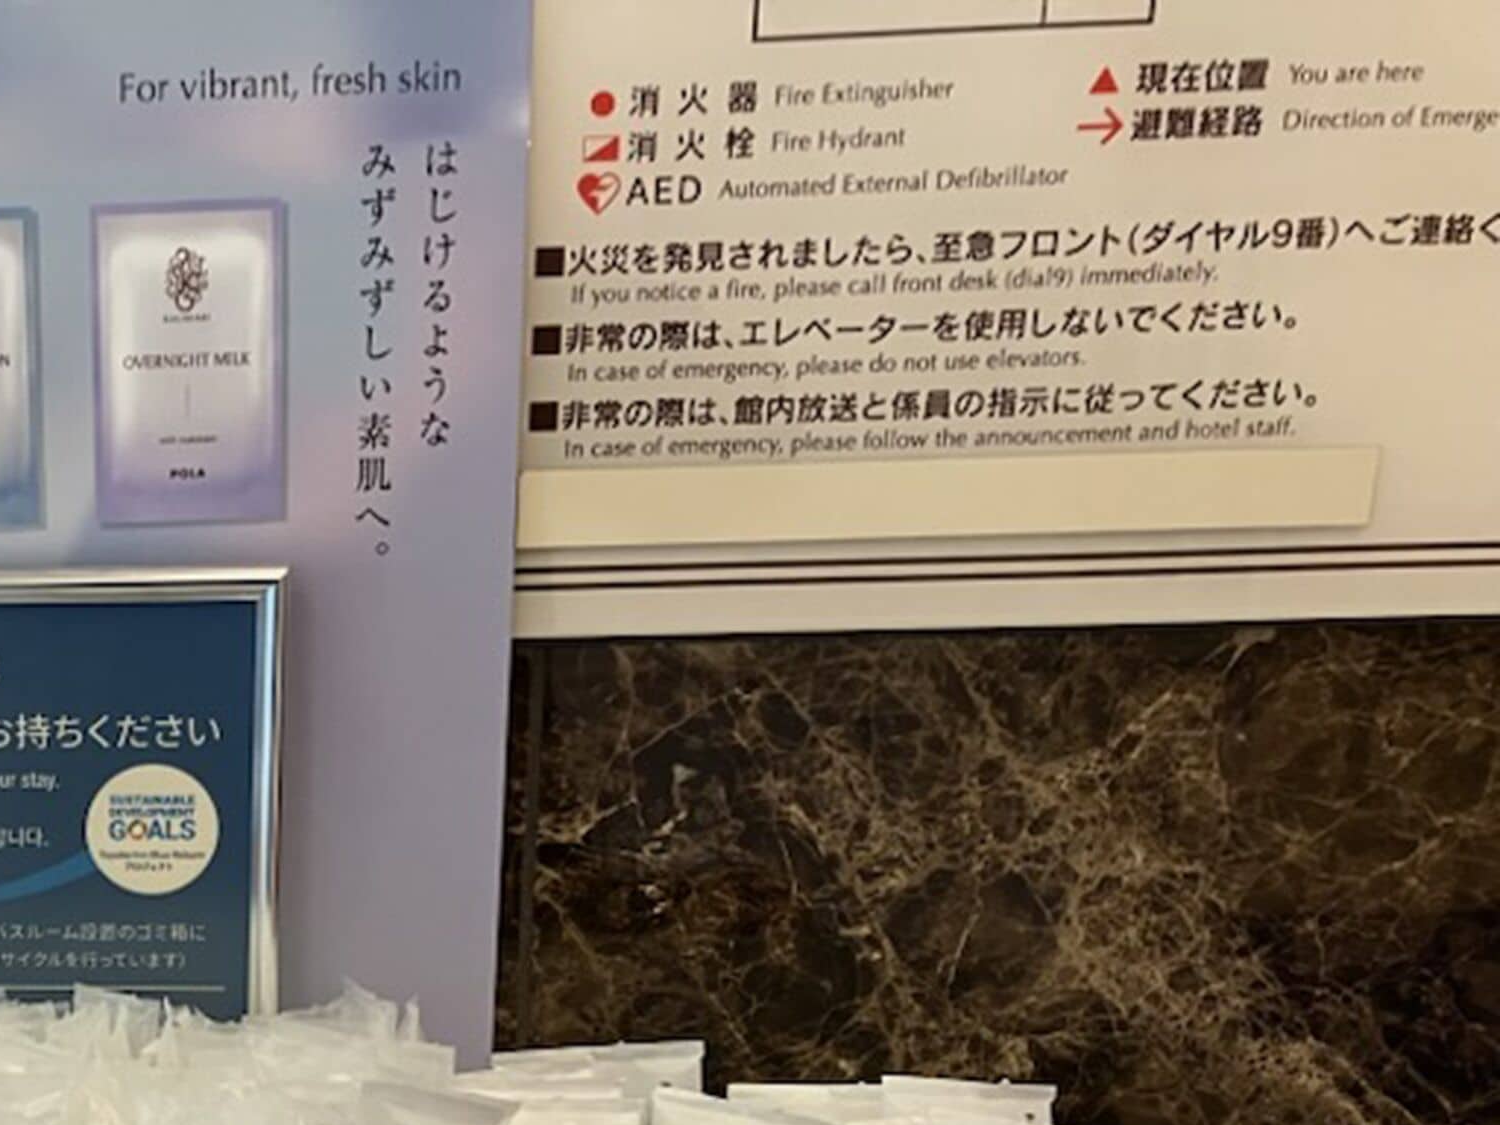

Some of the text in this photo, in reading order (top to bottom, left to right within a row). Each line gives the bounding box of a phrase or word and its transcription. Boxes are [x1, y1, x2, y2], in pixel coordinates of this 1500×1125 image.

[118, 59, 462, 104] For vibrant, fresh skin
[1135, 59, 1269, 96] 現在位置
[1288, 61, 1425, 85] You are here
[773, 77, 955, 107] Fire Extinguisher
[1129, 104, 1265, 142] 避難経路
[1281, 106, 1386, 132] Direction
[1391, 106, 1414, 129] of
[771, 127, 906, 155] Fire Hydrant
[625, 175, 703, 207] AED
[717, 163, 1069, 200] Automated External Defibrillator
[419, 140, 460, 448] はじけるような
[570, 282, 587, 305] If
[591, 286, 630, 309] you
[636, 281, 701, 303] notice
[707, 284, 720, 300] a
[725, 279, 766, 301] fire,
[773, 276, 842, 305] please
[846, 274, 886, 296] call
[890, 269, 942, 296] front
[949, 267, 998, 292] desk
[1079, 260, 1219, 287] immediately.
[122, 350, 252, 371] OVERNIGHT MILK
[567, 349, 1086, 385] In case of emergency, please do not use elevators.
[564, 416, 1296, 461] In case of emergency, please follow the announcement and hotel staff.
[21, 772, 60, 794] stay.
[107, 818, 197, 841] GOALS
